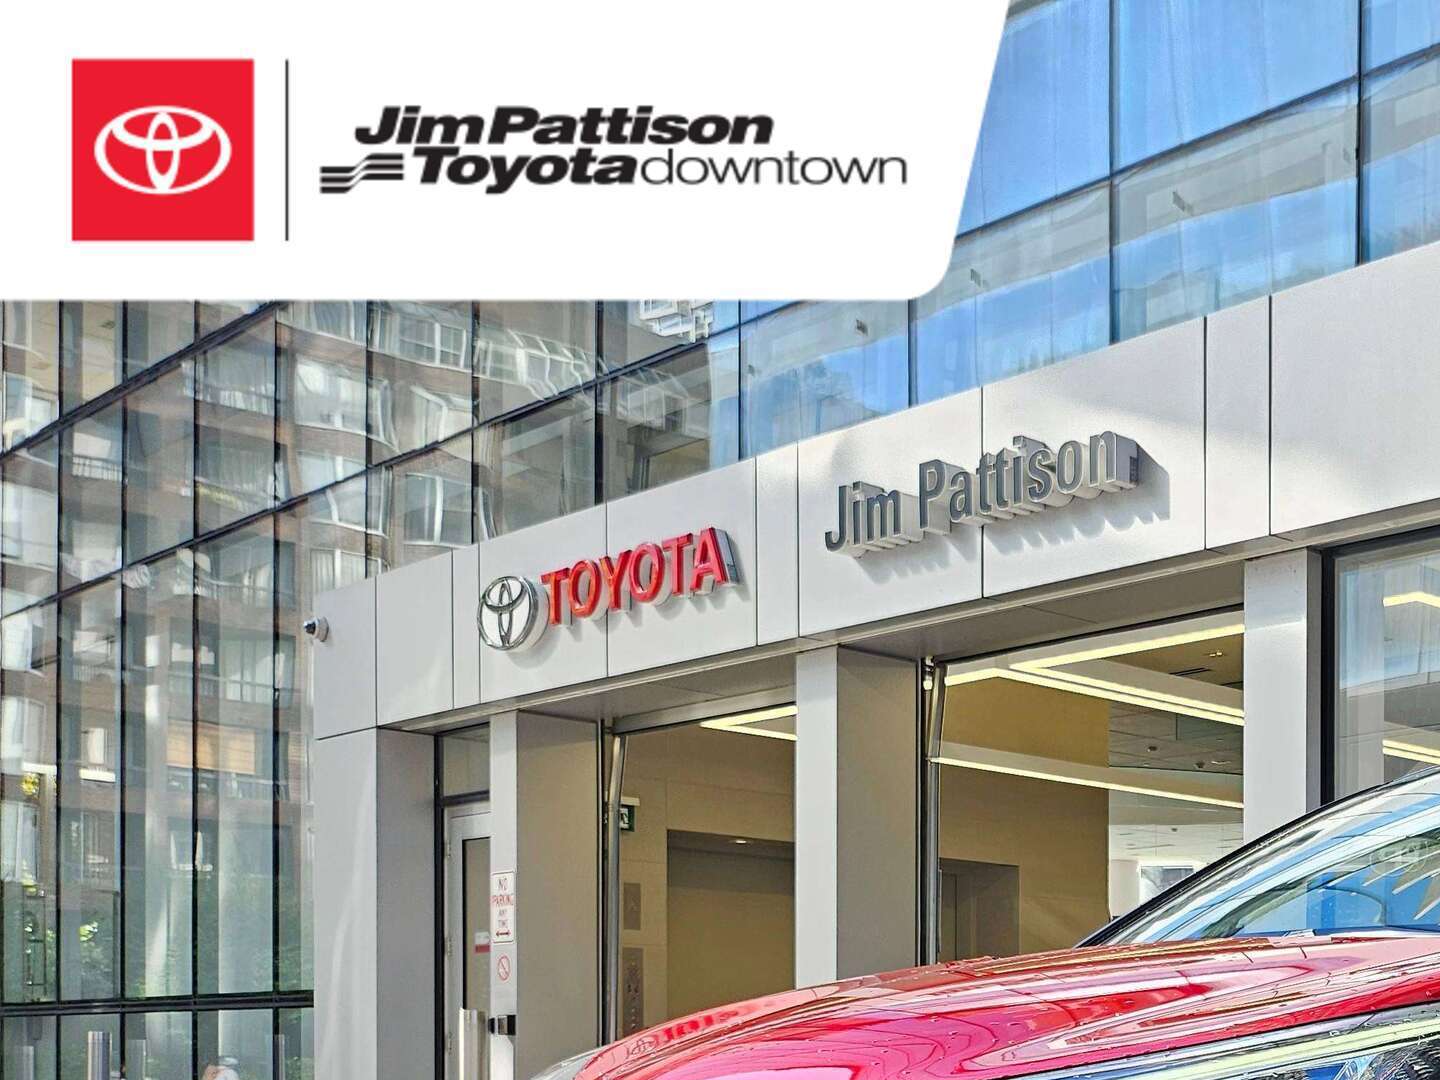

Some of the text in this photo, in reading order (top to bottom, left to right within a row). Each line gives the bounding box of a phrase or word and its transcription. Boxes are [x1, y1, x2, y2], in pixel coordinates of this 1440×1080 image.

[824, 431, 1138, 558] Jim Pattison
[540, 526, 739, 627] TOYOTA
